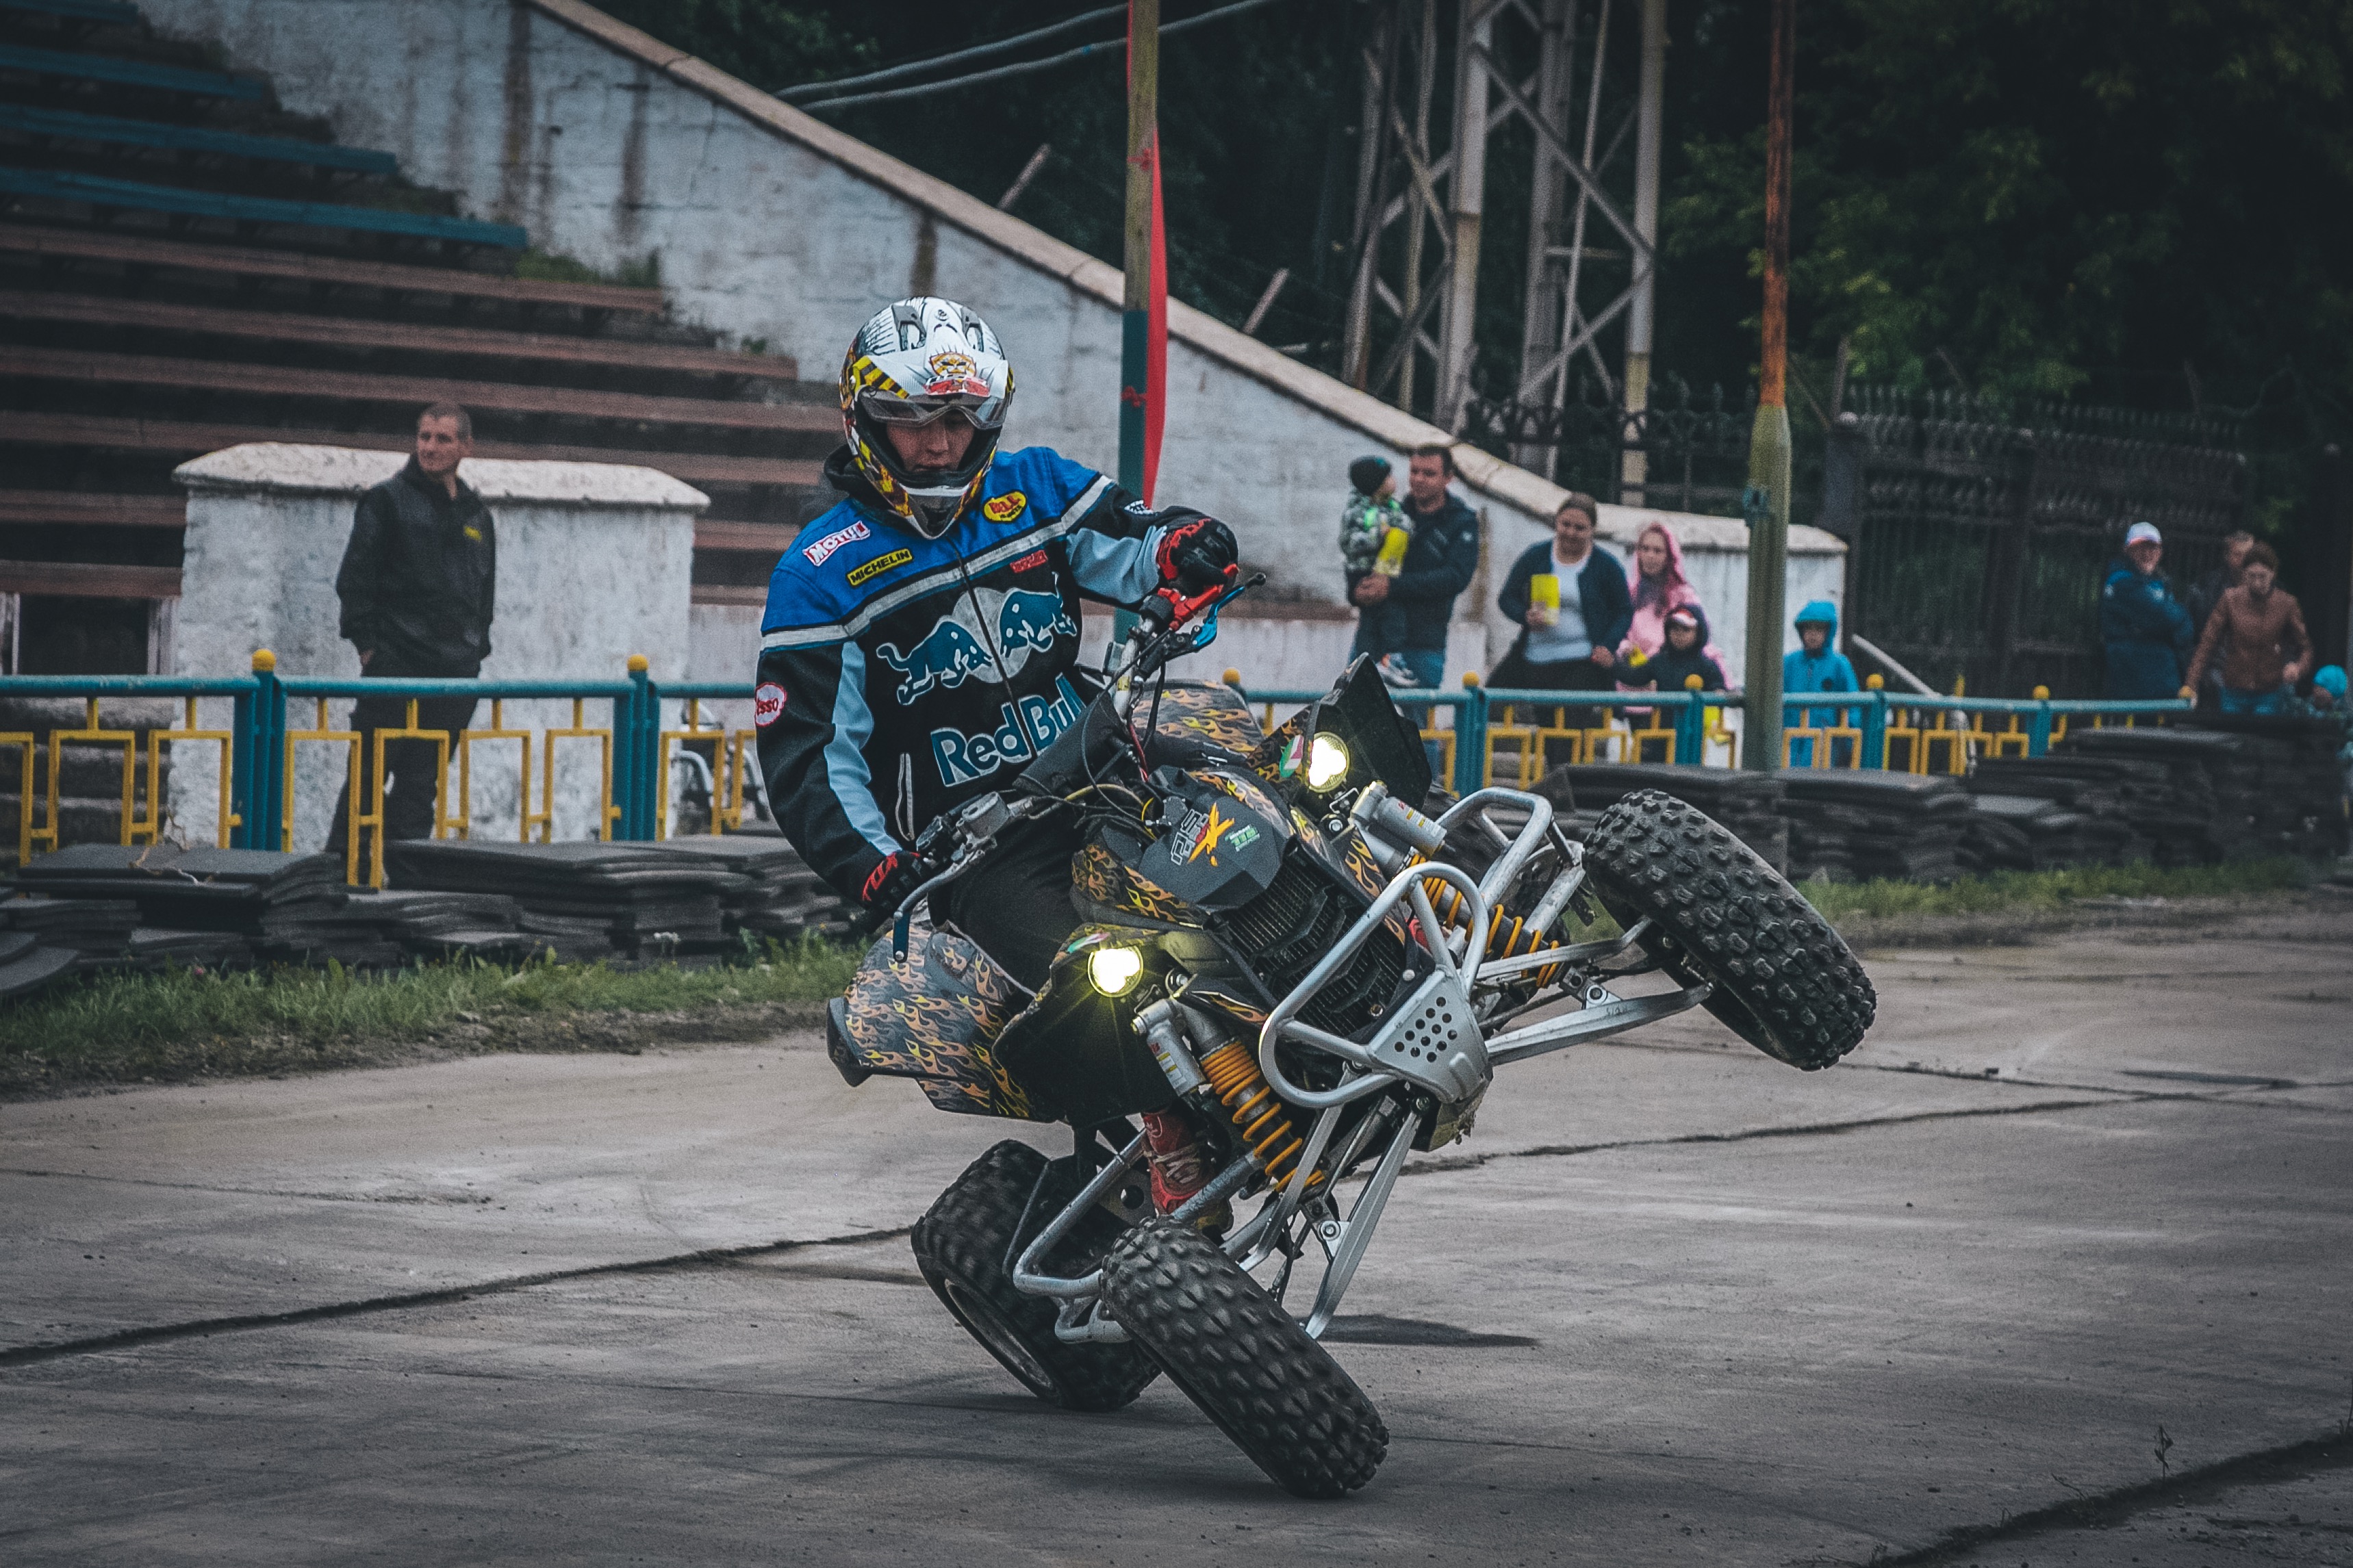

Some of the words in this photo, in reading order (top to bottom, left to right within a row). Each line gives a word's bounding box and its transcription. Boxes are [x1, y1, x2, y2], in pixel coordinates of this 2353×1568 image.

[807, 522, 871, 565] MOTUL
[850, 550, 911, 583] MICHELIN
[930, 702, 1032, 787] Red
